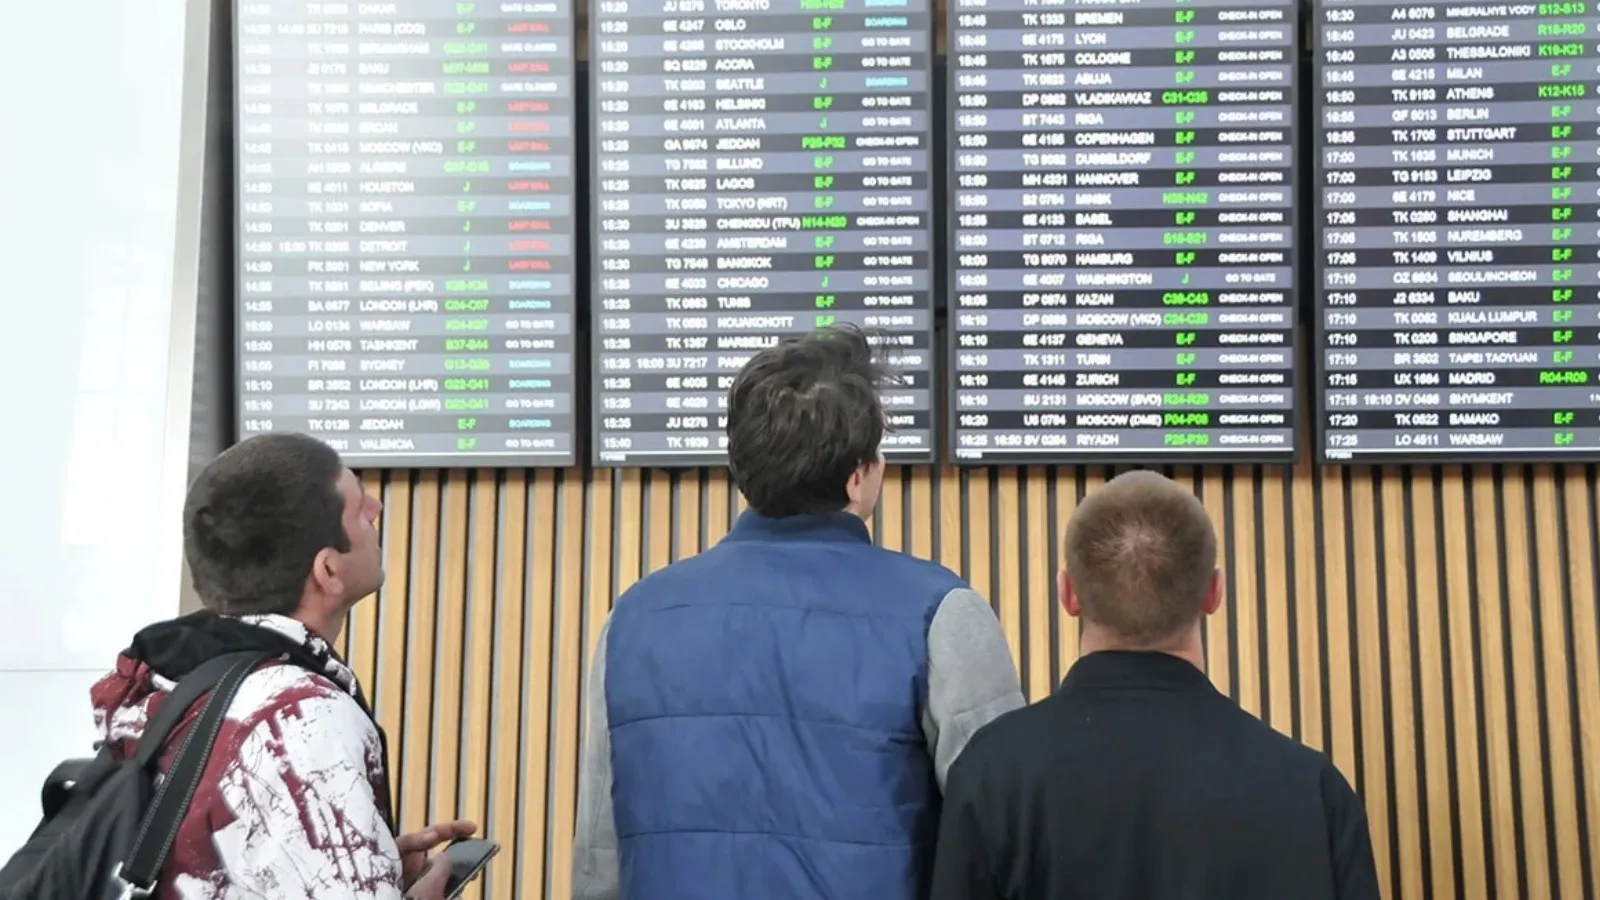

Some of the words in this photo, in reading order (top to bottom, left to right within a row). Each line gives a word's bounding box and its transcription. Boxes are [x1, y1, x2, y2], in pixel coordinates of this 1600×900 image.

[1508, 4, 1536, 16] VODY
[1075, 33, 1106, 44] LYON
[1392, 28, 1406, 40] JU
[1447, 26, 1509, 38] BELGRADE
[1446, 46, 1530, 58] THESSALONIKI
[1447, 67, 1482, 79] MILAN
[1551, 64, 1572, 77] E-F
[1392, 89, 1408, 101] TK
[1446, 87, 1494, 100] ATHENS
[1447, 108, 1489, 120] BERLIN
[1075, 132, 1154, 145] COPENHAGEN
[1392, 130, 1408, 142] TK
[1447, 127, 1516, 140] STUTTGART
[1551, 125, 1572, 138] E-F
[1327, 151, 1355, 163] 17:00
[1447, 148, 1493, 161] MUNICH
[1327, 171, 1355, 184] 17:00
[1447, 169, 1492, 181] LEIPZIG
[1552, 166, 1573, 179] E-F
[1447, 189, 1475, 201] NICE
[1447, 209, 1508, 222] SHANGHAI
[1552, 207, 1573, 221] E-F
[1448, 229, 1522, 242] NUREMBERG
[1393, 251, 1409, 263] TK
[1447, 250, 1493, 262] VILNIUS
[1552, 248, 1572, 261] E-F
[1328, 273, 1356, 284] 17:10
[1076, 293, 1114, 305] KAZAN
[1328, 293, 1356, 305] 17:10
[1448, 291, 1480, 303] BAKU
[1552, 288, 1573, 302] E-F
[1076, 313, 1129, 325] MOSCOW
[1328, 313, 1357, 325] 17:10
[1448, 311, 1486, 323] KUALA
[1488, 311, 1537, 322] LUMPUR
[1552, 309, 1573, 322] E-F
[1449, 331, 1517, 343] SINGAPORE
[1553, 329, 1573, 344] E-F
[1023, 354, 1039, 366] TK
[1076, 353, 1111, 365] TURIN
[1328, 353, 1357, 365] 17:10
[1449, 352, 1483, 364] TAIPEI
[1485, 351, 1537, 363] TAOYUAN
[1076, 374, 1119, 385] ZURICH
[1394, 373, 1412, 385] UX
[1449, 372, 1495, 384] MADRID
[1077, 393, 1129, 405] MOSCOW
[1449, 393, 1513, 404] SHYMKENT
[1077, 414, 1128, 426] MOSCOW
[1329, 414, 1358, 426] 17:20
[1395, 413, 1411, 425] TK
[1449, 413, 1500, 425] BAMAKO
[1553, 411, 1574, 425] E-F
[1077, 434, 1119, 446] RIYADH
[1395, 434, 1412, 446] LO
[1449, 433, 1503, 445] WARSAW
[1553, 432, 1574, 445] E-F
